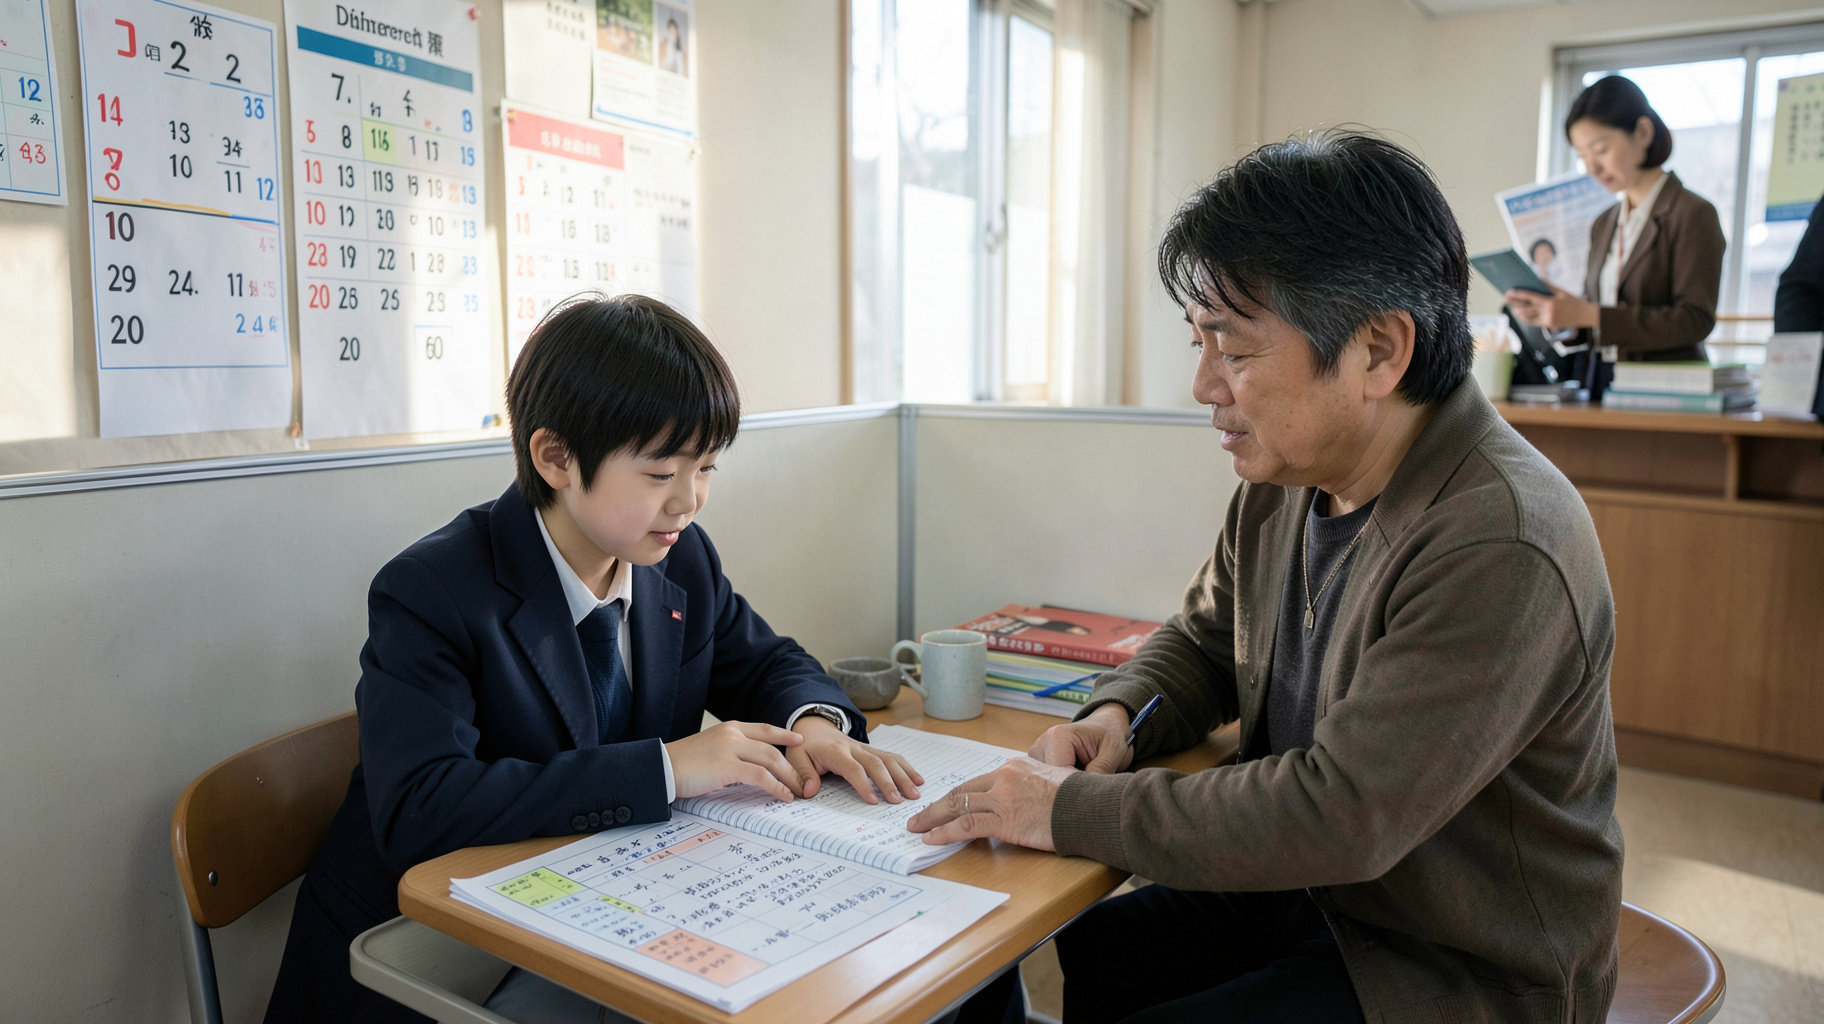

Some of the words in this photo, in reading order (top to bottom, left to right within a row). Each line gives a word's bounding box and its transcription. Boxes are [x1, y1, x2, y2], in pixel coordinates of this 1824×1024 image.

[171, 41, 190, 72] 2
[226, 54, 241, 83] 2
[18, 76, 42, 102] 12
[342, 125, 351, 148] 8
[169, 154, 192, 178] 10
[224, 170, 242, 193] 11
[257, 177, 274, 200] 12
[106, 211, 135, 242] 10
[306, 201, 326, 225] 10
[108, 264, 136, 293] 29
[309, 284, 330, 309] 20
[111, 315, 144, 344] 20
[340, 337, 360, 361] 20
